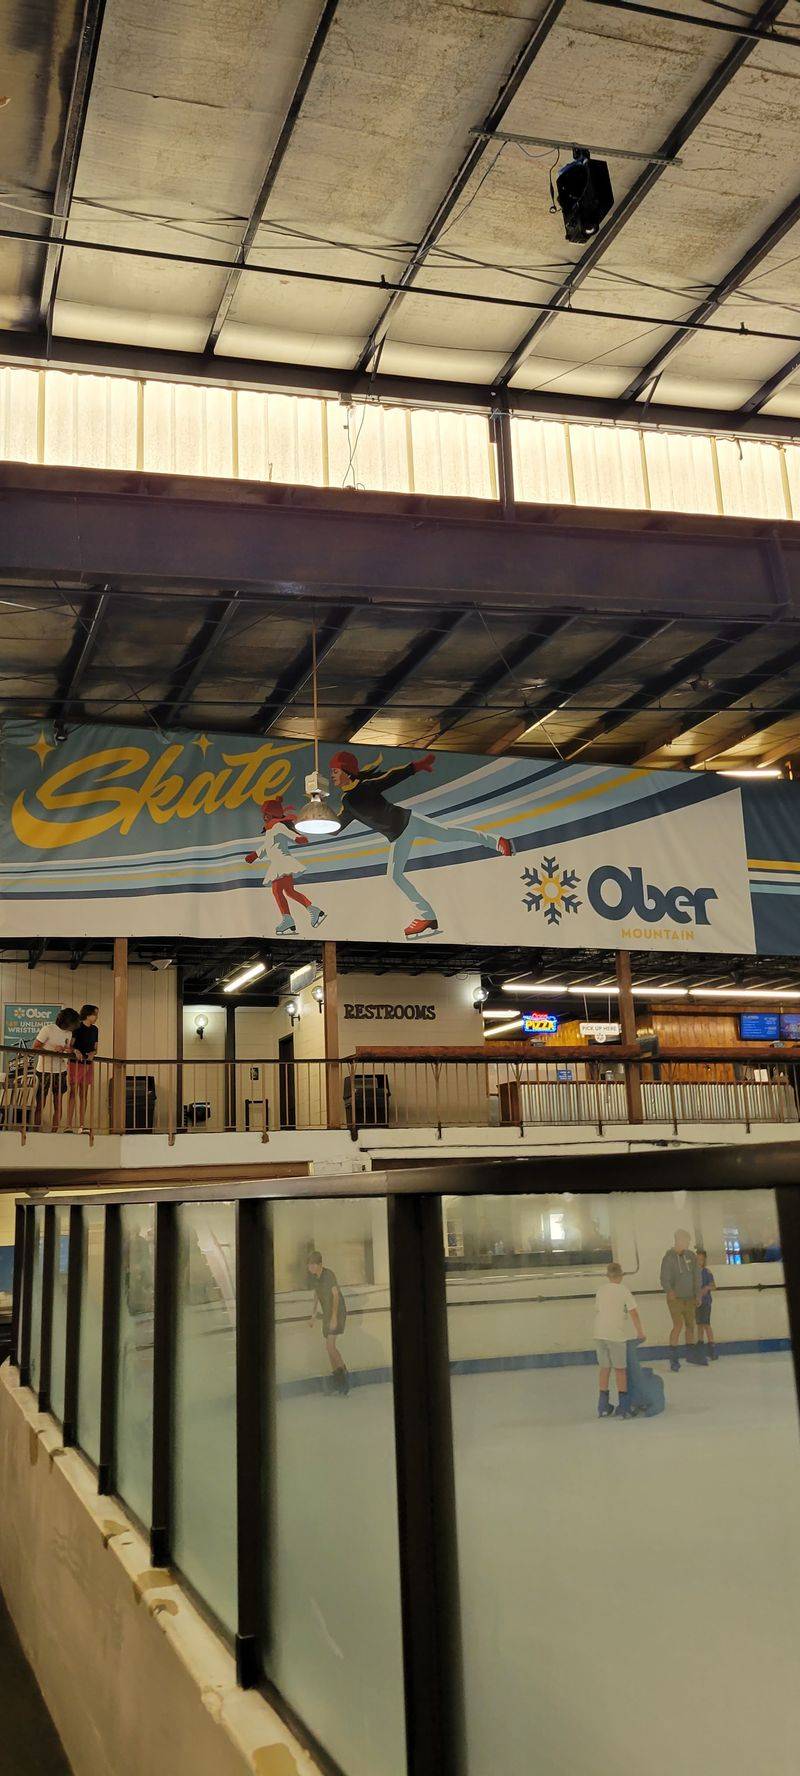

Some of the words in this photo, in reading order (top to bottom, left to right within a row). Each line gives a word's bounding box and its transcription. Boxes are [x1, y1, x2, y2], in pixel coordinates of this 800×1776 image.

[11, 742, 312, 849] Skate
[587, 865, 719, 926] Ober
[621, 928, 695, 940] MOUNTAIN
[25, 1008, 52, 1019] Ober
[343, 1003, 436, 1020] RESTROOMS
[526, 1020, 554, 1030] PIZZA
